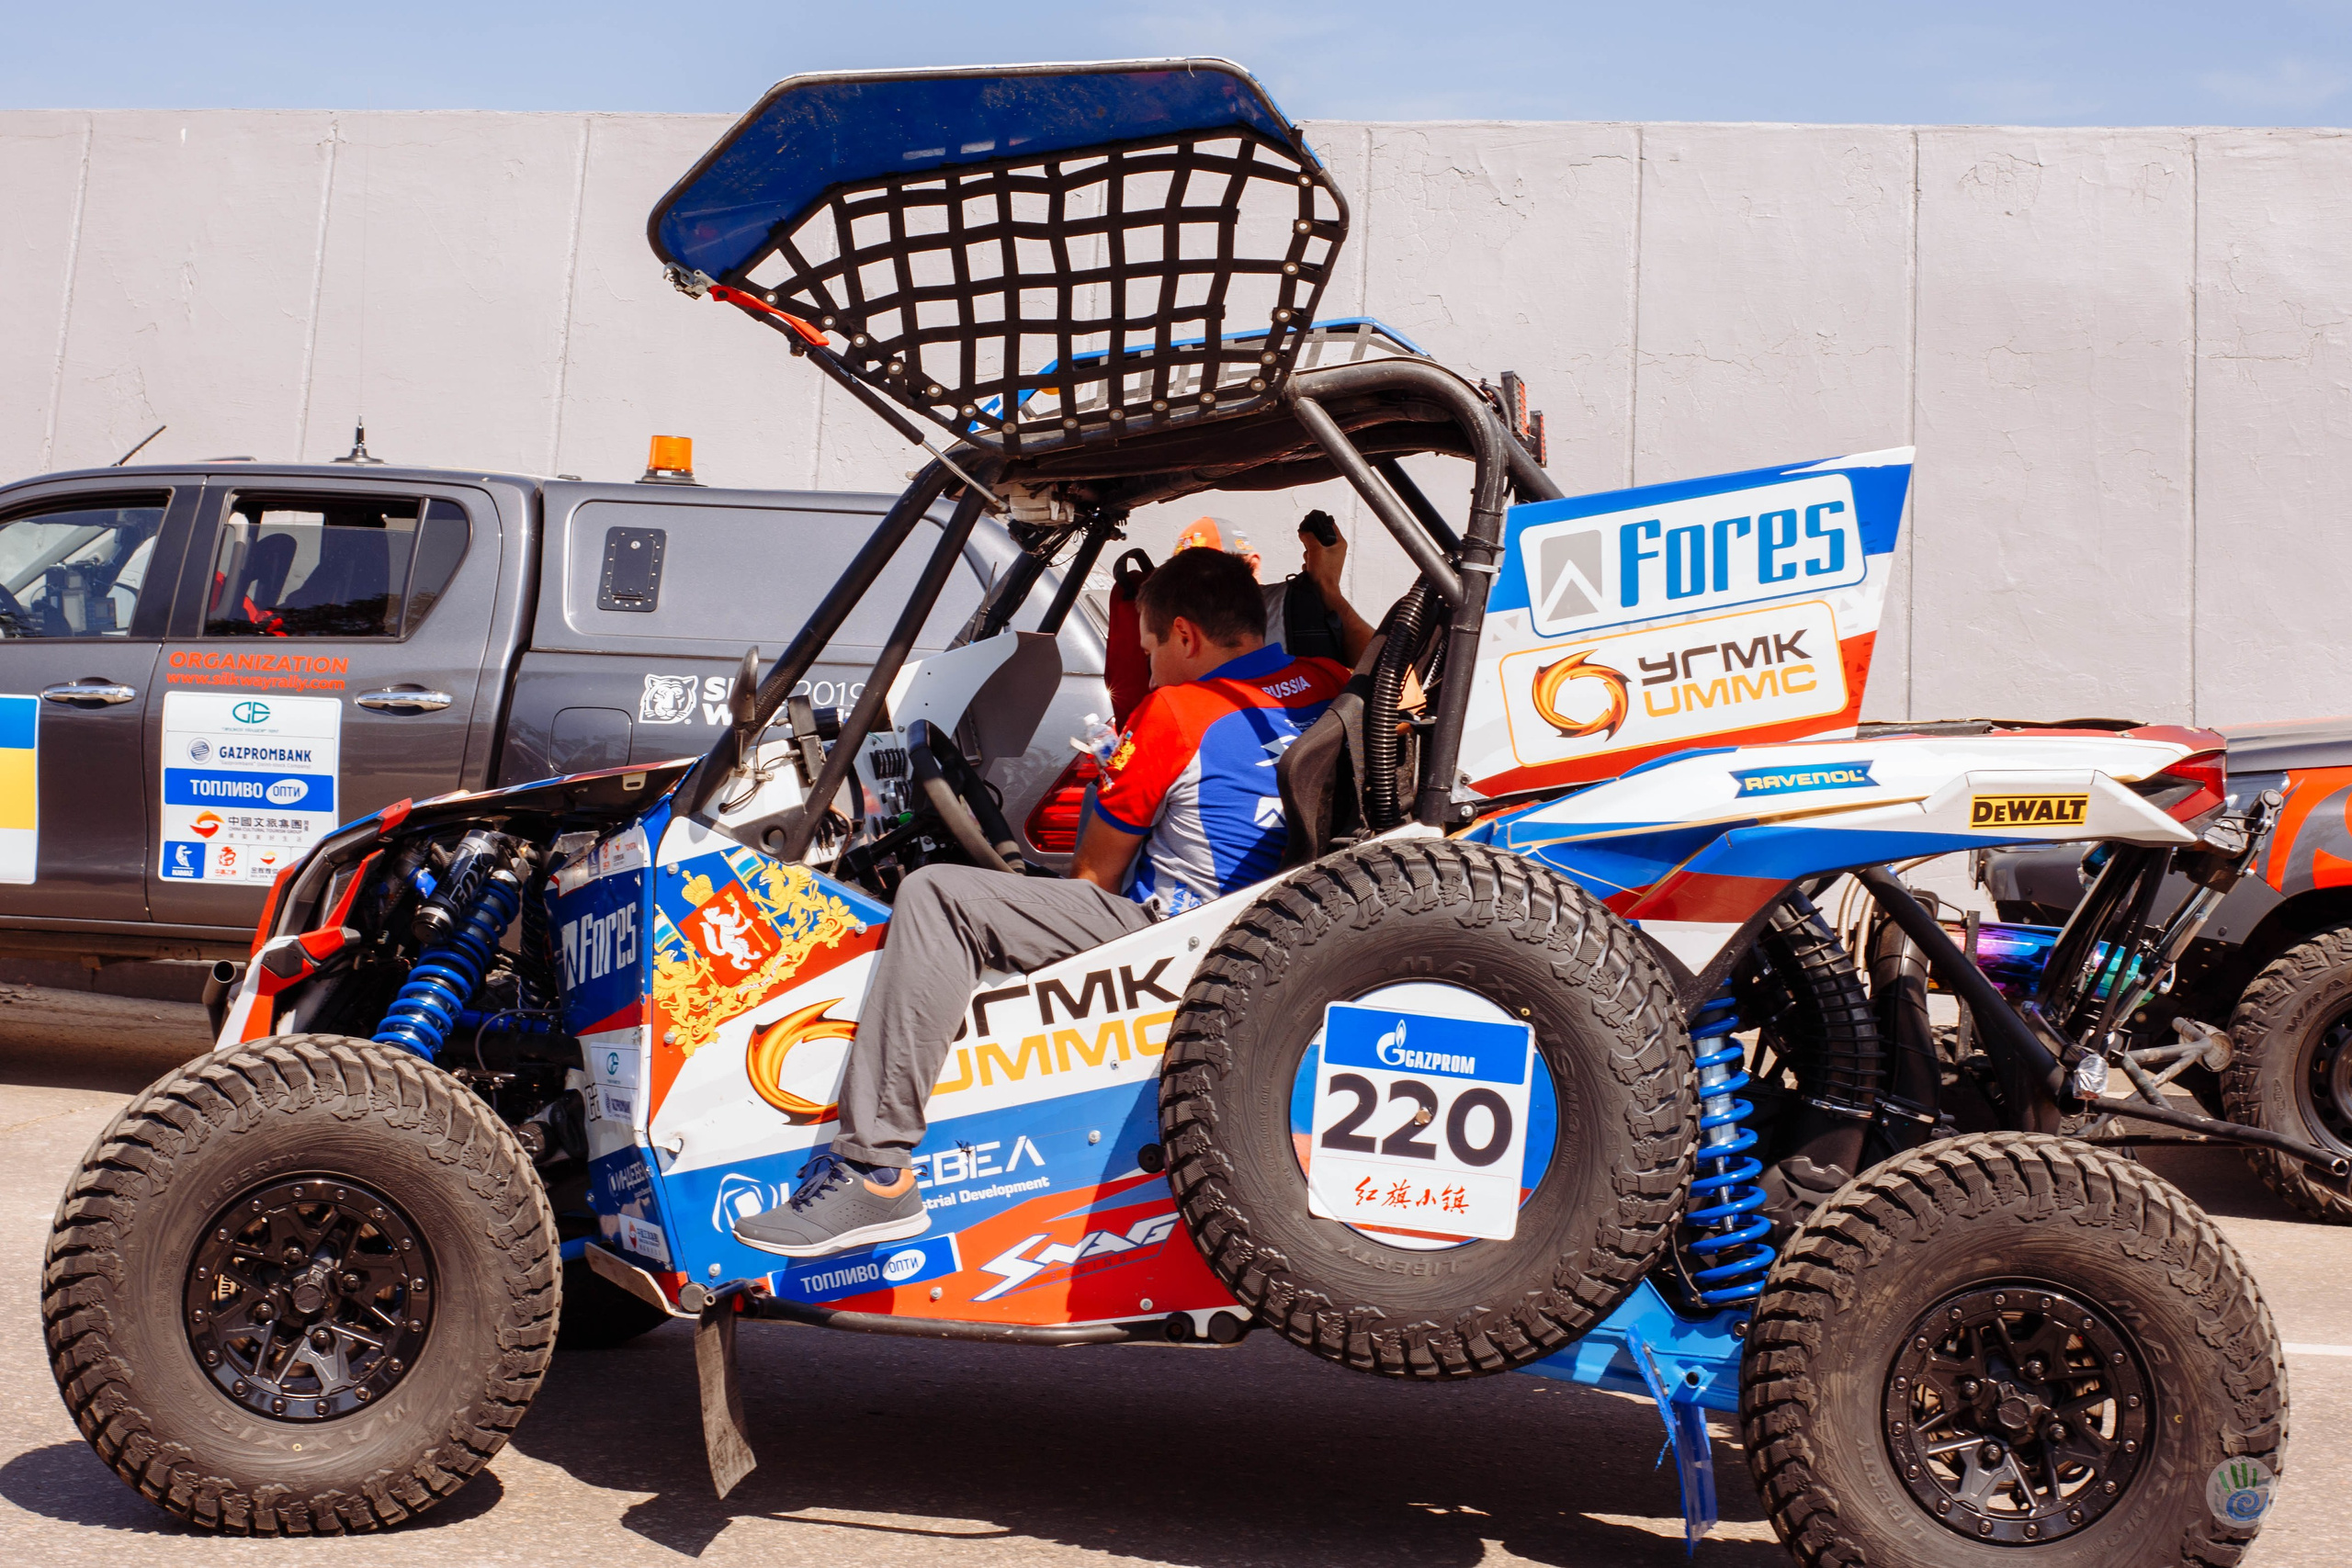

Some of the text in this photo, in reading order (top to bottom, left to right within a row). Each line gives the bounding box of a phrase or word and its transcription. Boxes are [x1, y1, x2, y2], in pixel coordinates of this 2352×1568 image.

[169, 651, 349, 674] ORGANIZATION
[1637, 629, 1814, 687] УГМК
[166, 671, 345, 692] www.silkwayrally.com
[1262, 675, 1312, 699] RUSSIA
[1644, 664, 1818, 717] UMMC
[219, 746, 312, 762] GAZPROMBANK
[189, 779, 300, 799] ТОПЛИВО ОПТИ
[1746, 769, 1865, 791] RAVENOL
[952, 956, 1182, 1043] ГМК
[1405, 1049, 1476, 1075] GAZPROM
[1320, 1073, 1513, 1168] 220
[198, 1151, 305, 1211] LIBERTY
[922, 1176, 1050, 1211] strial Development
[1355, 1177, 1470, 1214] 红旗小镇
[800, 1257, 919, 1293] ТОПЛИВО ОПТИ
[1050, 1254, 1127, 1280] RACING
[1337, 1243, 1459, 1278] LIBERTY
[209, 1402, 409, 1452] MAXXIS
[1856, 1438, 1926, 1542] LIBERTY
